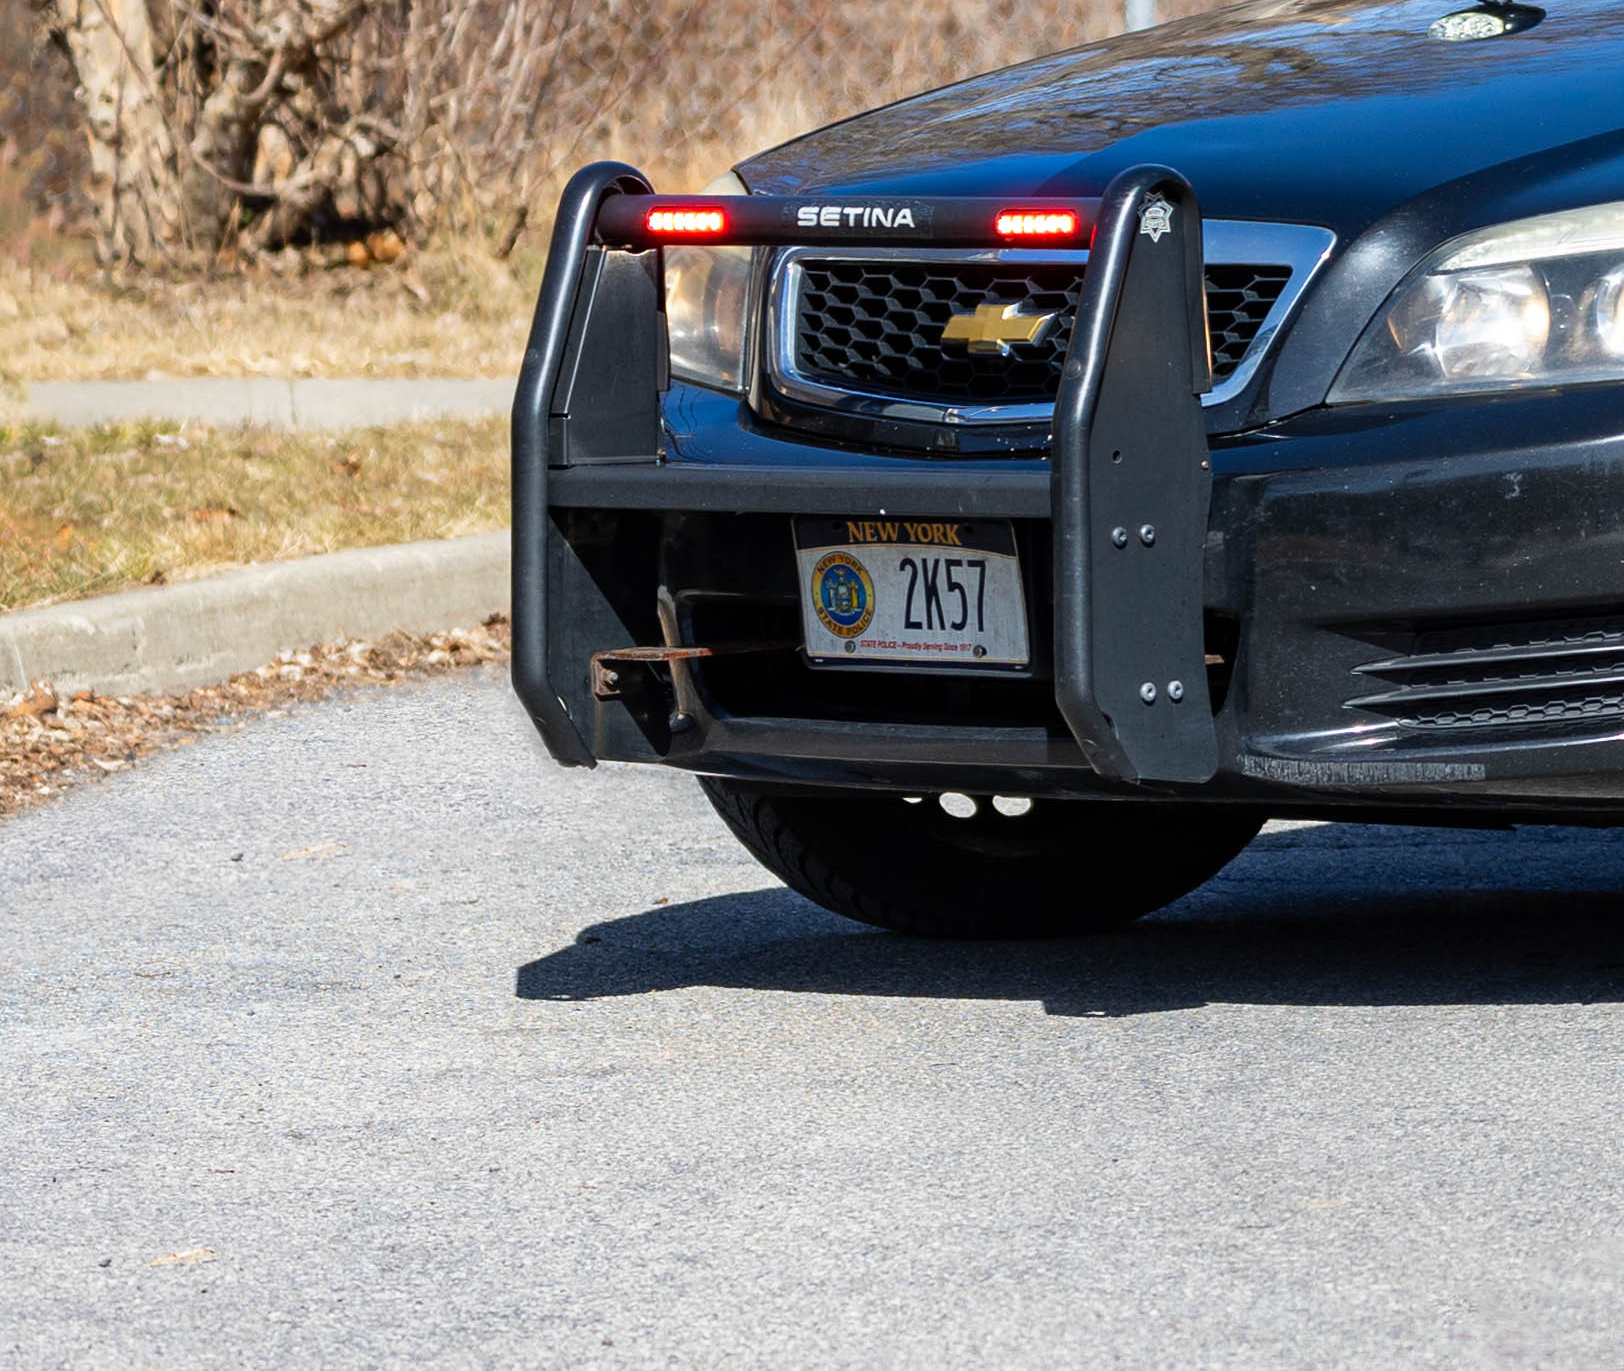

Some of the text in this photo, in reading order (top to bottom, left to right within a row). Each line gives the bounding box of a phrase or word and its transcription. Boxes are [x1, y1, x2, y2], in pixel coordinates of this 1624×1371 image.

[797, 206, 916, 228] SETINA
[846, 521, 963, 546] NEW YORK
[816, 553, 866, 575] NEW YORK
[899, 557, 986, 632] 2K57
[816, 606, 874, 636] STATE POLICE
